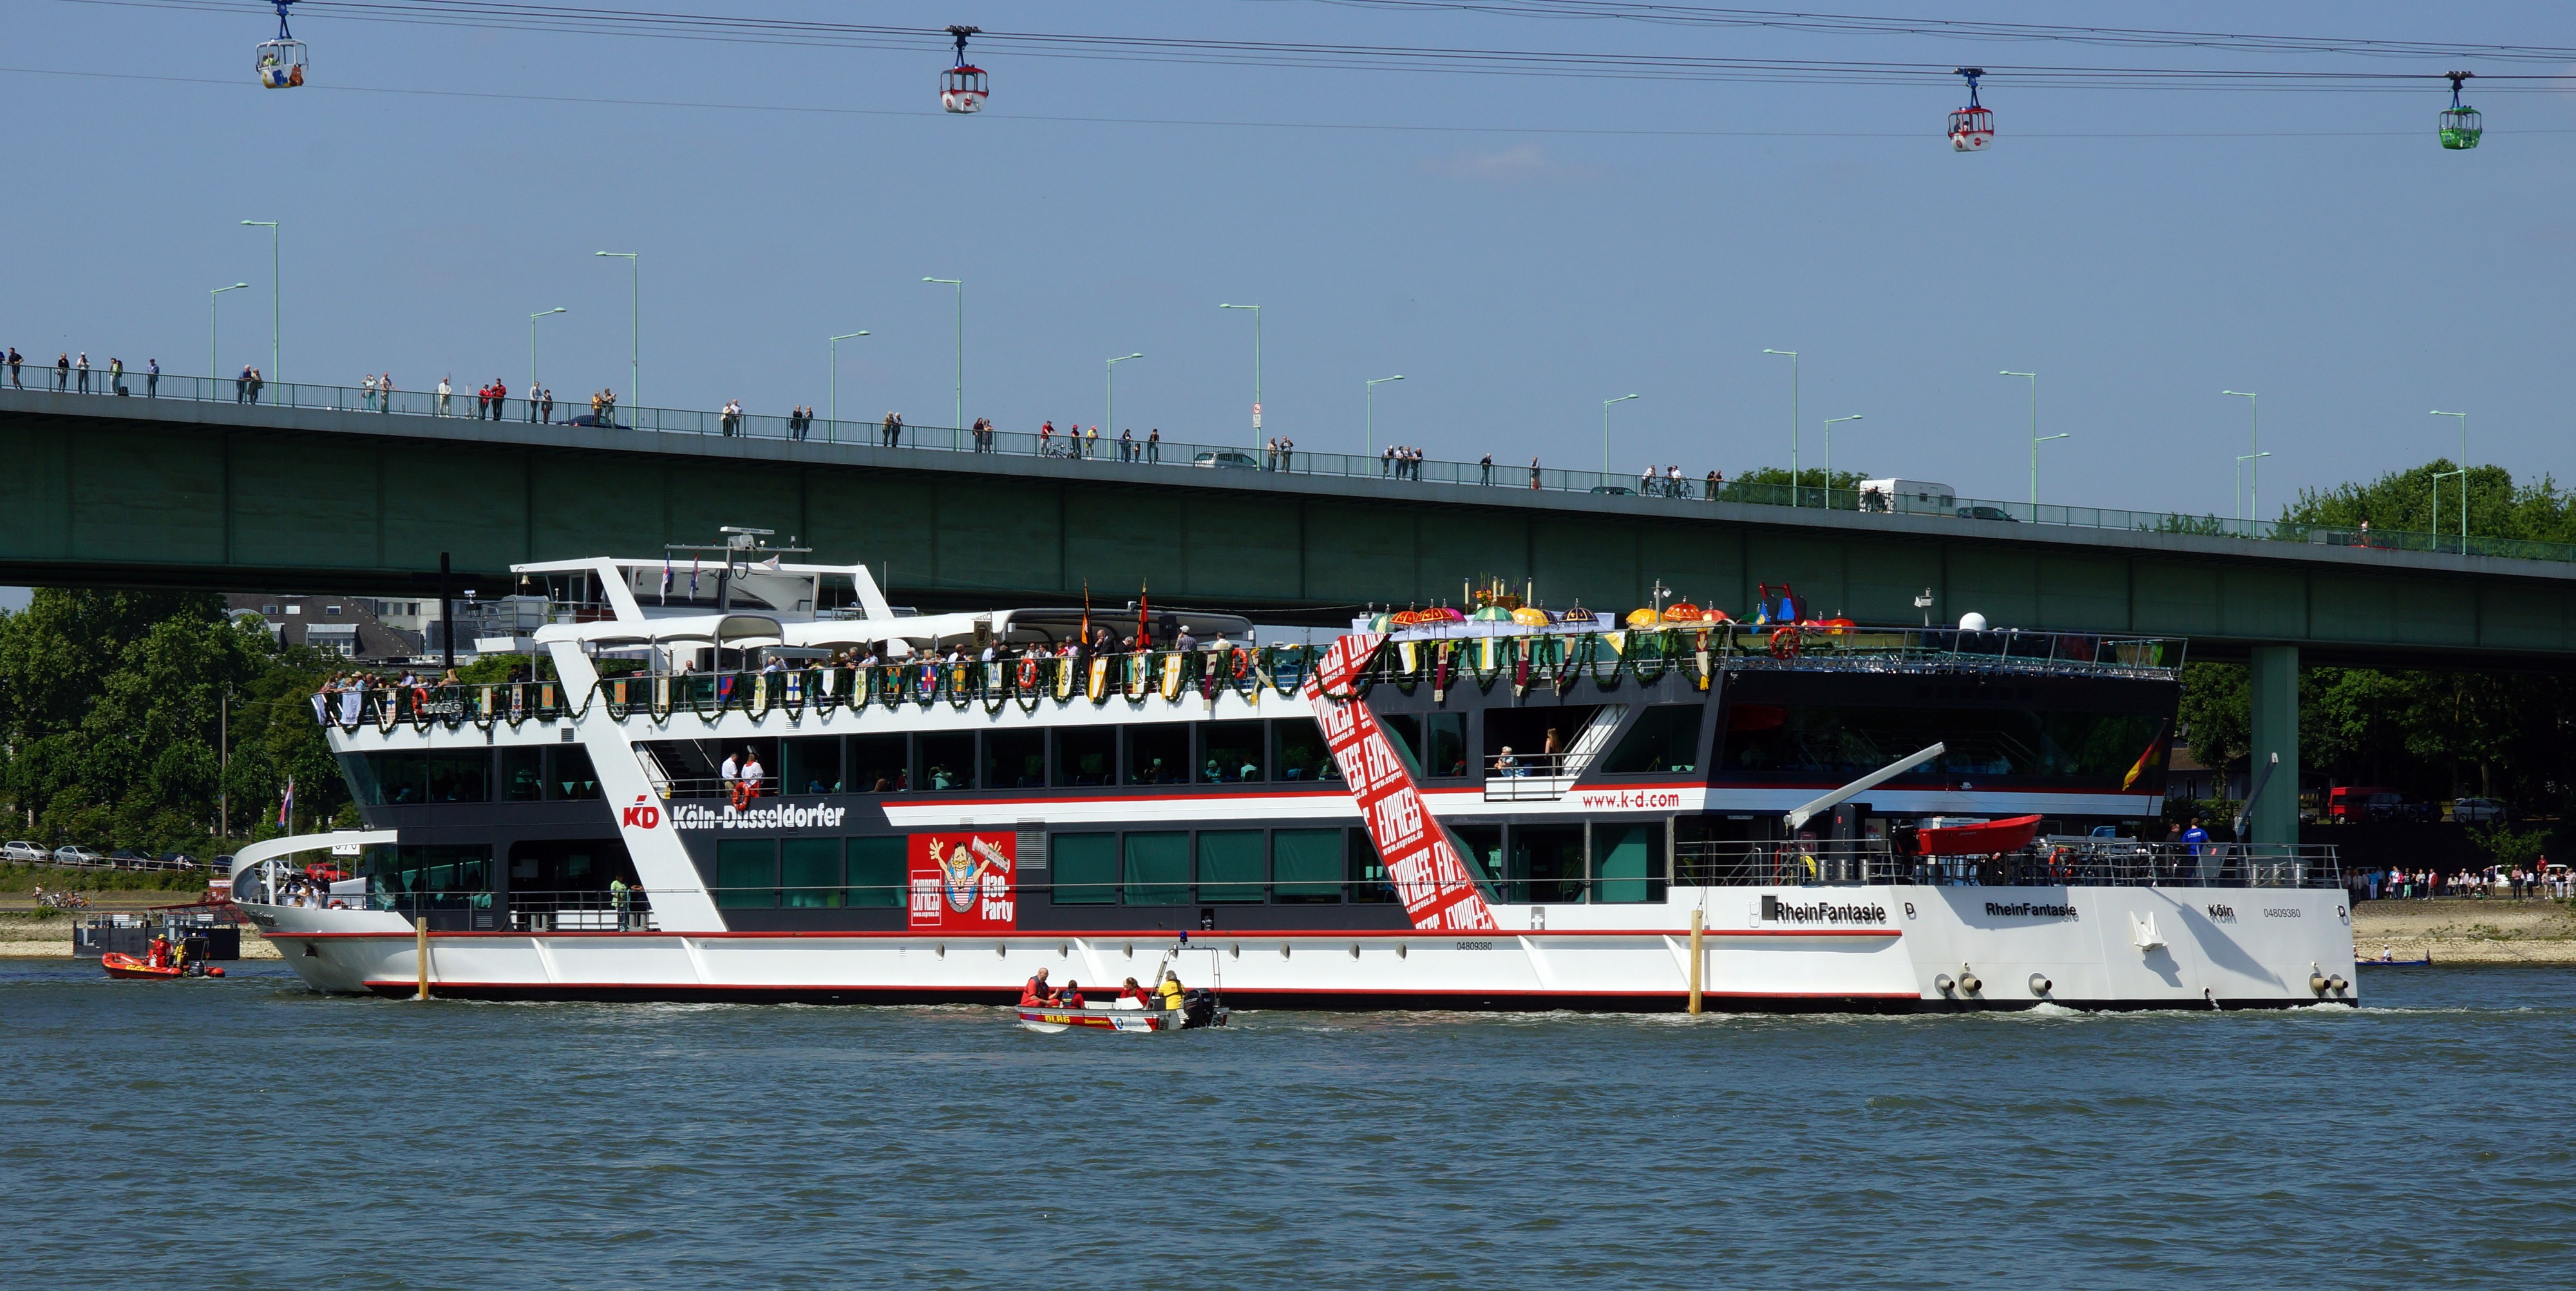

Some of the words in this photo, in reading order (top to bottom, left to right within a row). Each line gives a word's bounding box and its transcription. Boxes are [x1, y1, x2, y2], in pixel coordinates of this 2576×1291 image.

[1582, 790, 1679, 808] www.k-d.com
[623, 806, 659, 829] KD
[1375, 787, 1423, 846] EXPRESS
[1383, 830, 1424, 856] www.express.de
[982, 872, 1010, 898] Ü30-
[913, 911, 940, 919] www.express.de
[982, 898, 1013, 922] Party
[1775, 902, 1886, 921] RheinFantasie
[1904, 902, 1915, 915] D
[1985, 903, 2077, 916] RheinFantasie
[2207, 904, 2234, 917] Köln
[2264, 908, 2301, 918] 04809380
[2336, 905, 2346, 917] D
[1457, 942, 1492, 950] 04809380
[1045, 1015, 1070, 1024] DLRG
